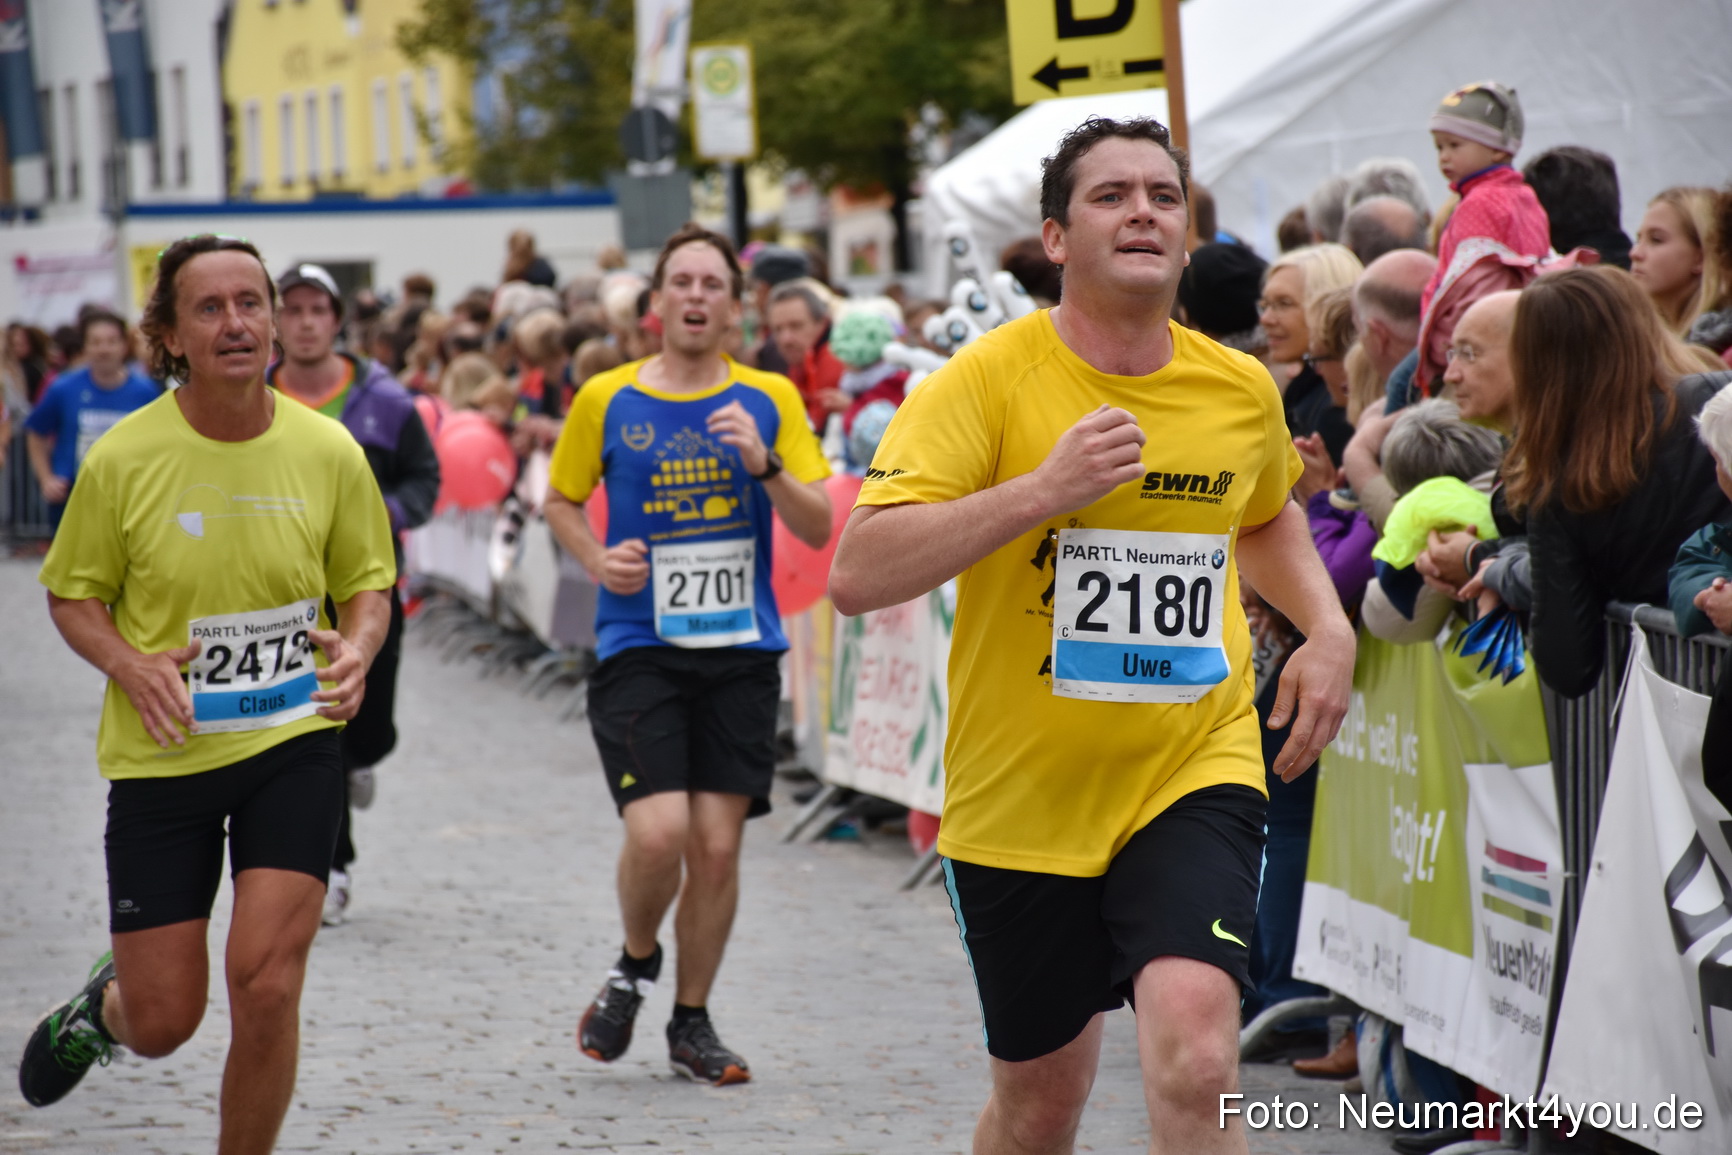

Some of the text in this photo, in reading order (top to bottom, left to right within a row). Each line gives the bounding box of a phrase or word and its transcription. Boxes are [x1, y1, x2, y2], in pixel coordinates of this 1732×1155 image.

[1142, 472, 1210, 494] swn
[1140, 492, 1223, 505] stadtwerke neumarkt
[1063, 545, 1206, 566] PARTL Neumarkt
[668, 567, 744, 607] 2701
[1075, 571, 1212, 638] 2180
[193, 615, 303, 639] PARTL Neumarkt
[1062, 627, 1069, 638] C
[206, 630, 307, 685] 2472
[1123, 653, 1172, 678] Uwe
[239, 692, 286, 715] Claus
